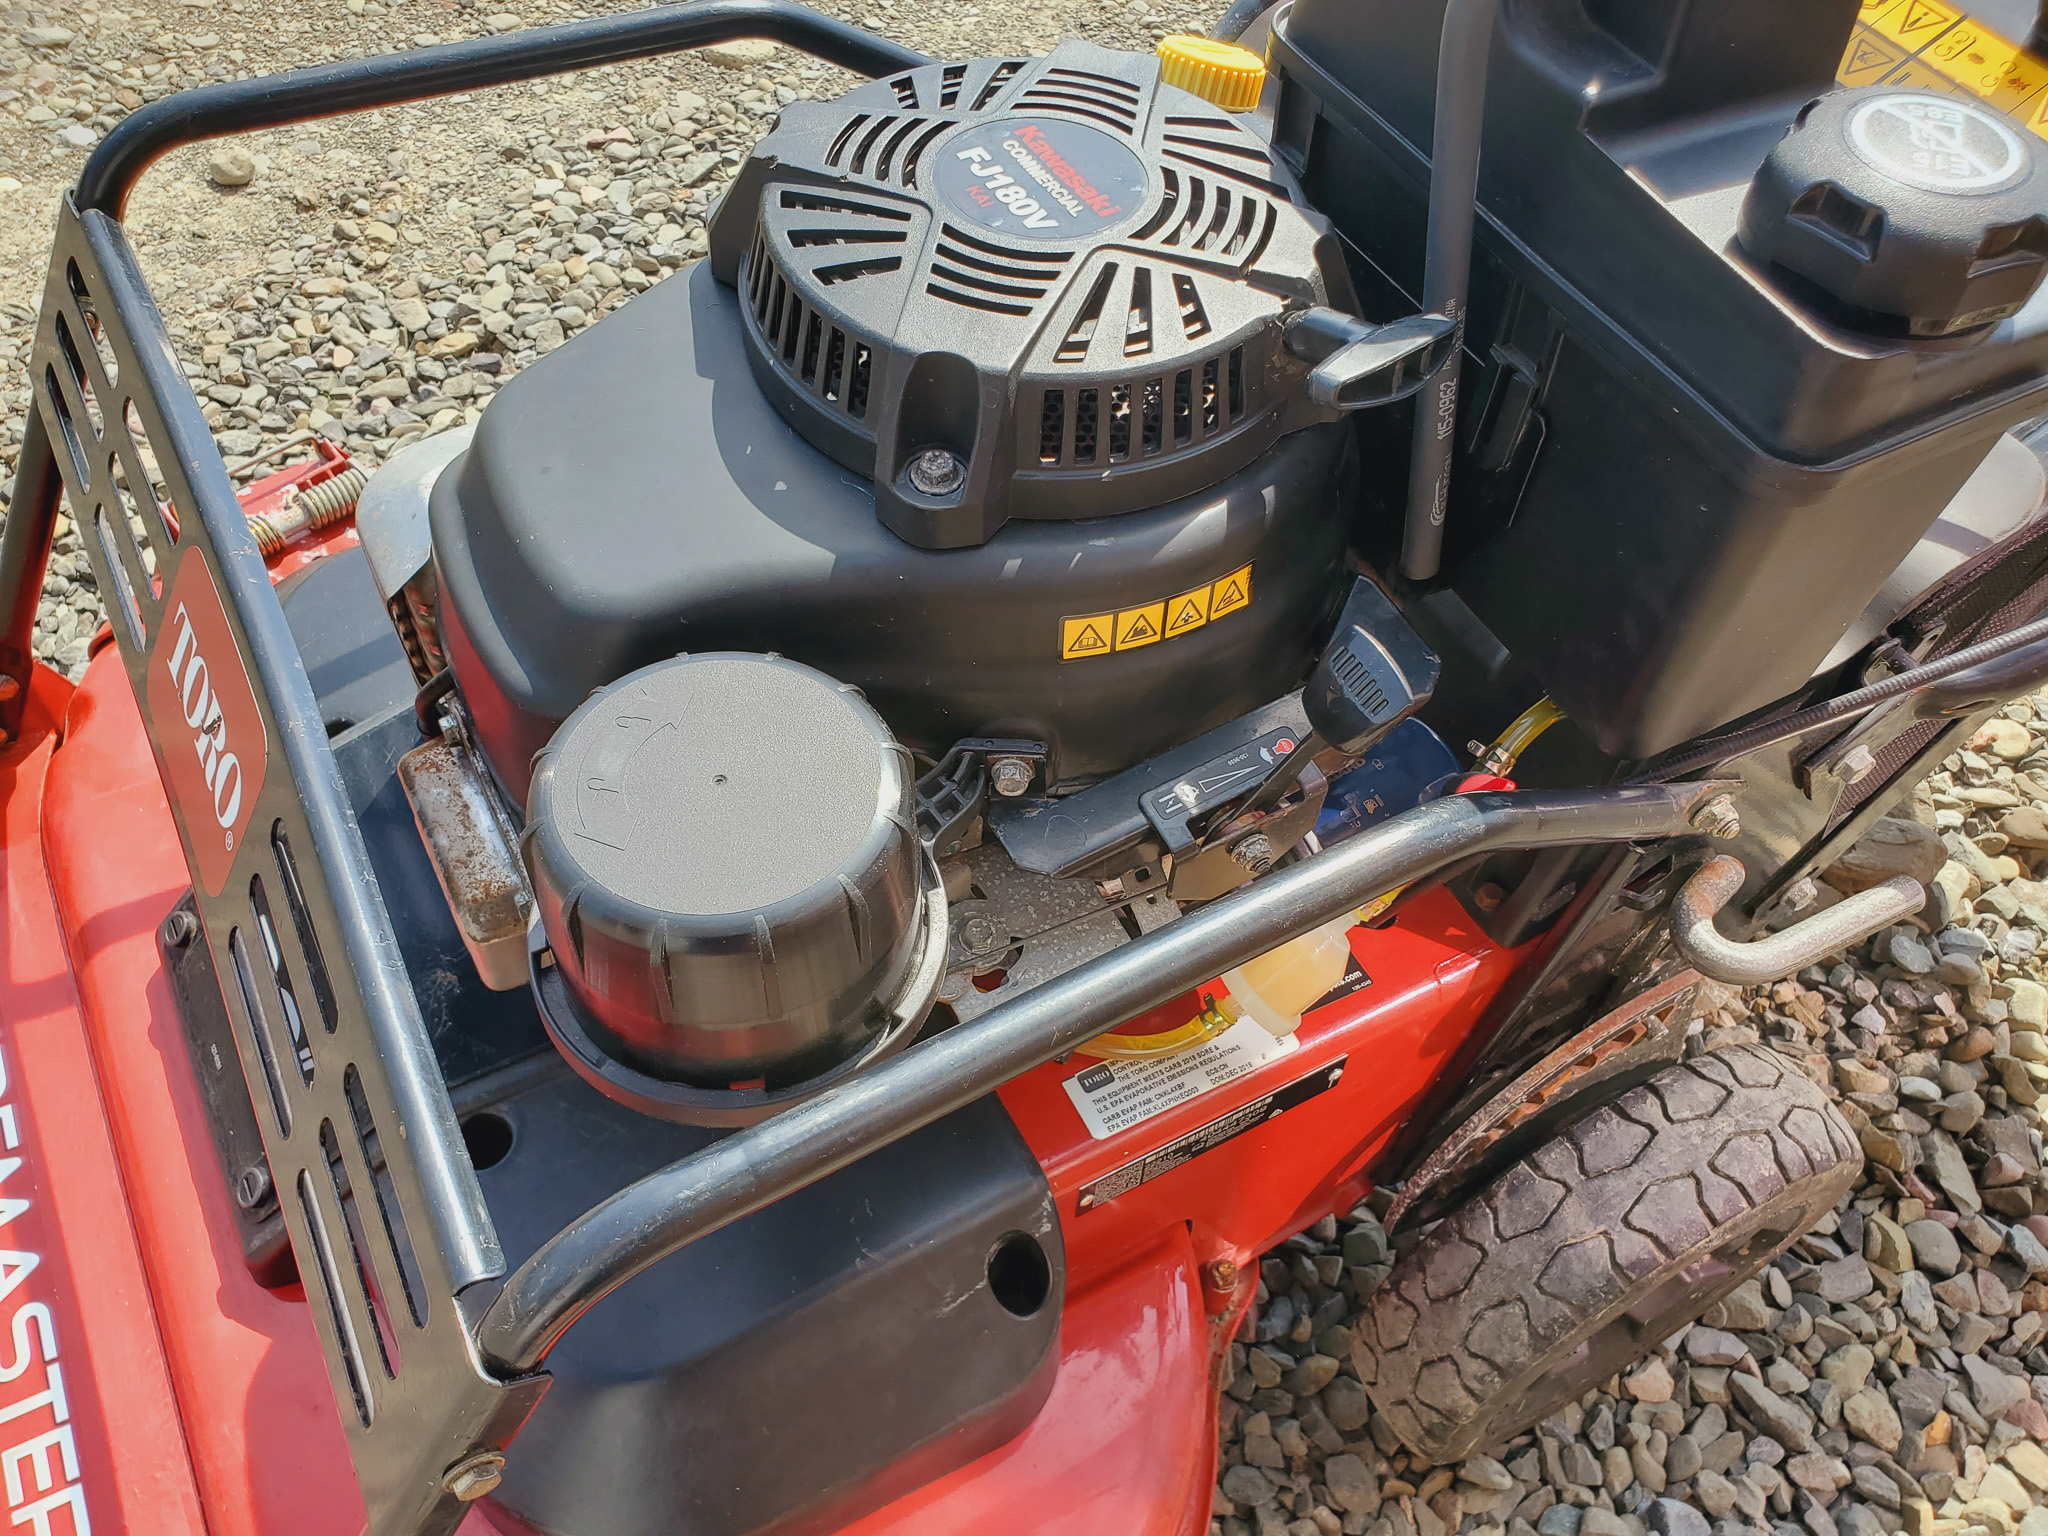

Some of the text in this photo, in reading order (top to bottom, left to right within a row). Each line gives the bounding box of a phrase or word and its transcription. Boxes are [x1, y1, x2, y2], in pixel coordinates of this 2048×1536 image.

[956, 146, 1059, 229] FJ180V
[965, 185, 995, 209] KAI
[1002, 139, 1085, 217] COMMERCIAL
[1014, 124, 1122, 218] Kawasaki
[1437, 377, 1457, 442] 115-0962
[166, 601, 242, 829] TORO
[1081, 1069, 1110, 1087] TORO
[1092, 1094, 1107, 1105] THIS
[1107, 1078, 1143, 1098] EQUIPMENT
[1142, 1069, 1164, 1083] MEETS
[1164, 1061, 1182, 1073] CARB
[1195, 1046, 1213, 1058] SORE
[1096, 1103, 1110, 1113] U.S.
[1110, 1097, 1124, 1107] EPA
[1123, 1077, 1166, 1101] EVAPORATIVE
[1165, 1062, 1199, 1081] EMISSIONS
[1117, 1072, 1130, 1082] THE
[1130, 1064, 1148, 1076] TORO
[1102, 1111, 1121, 1124] CARB
[1120, 1103, 1138, 1115] EVAP
[1138, 1096, 1154, 1107] FAM:
[1106, 1122, 1121, 1132] EPA
[1120, 1114, 1138, 1126] EVAP
